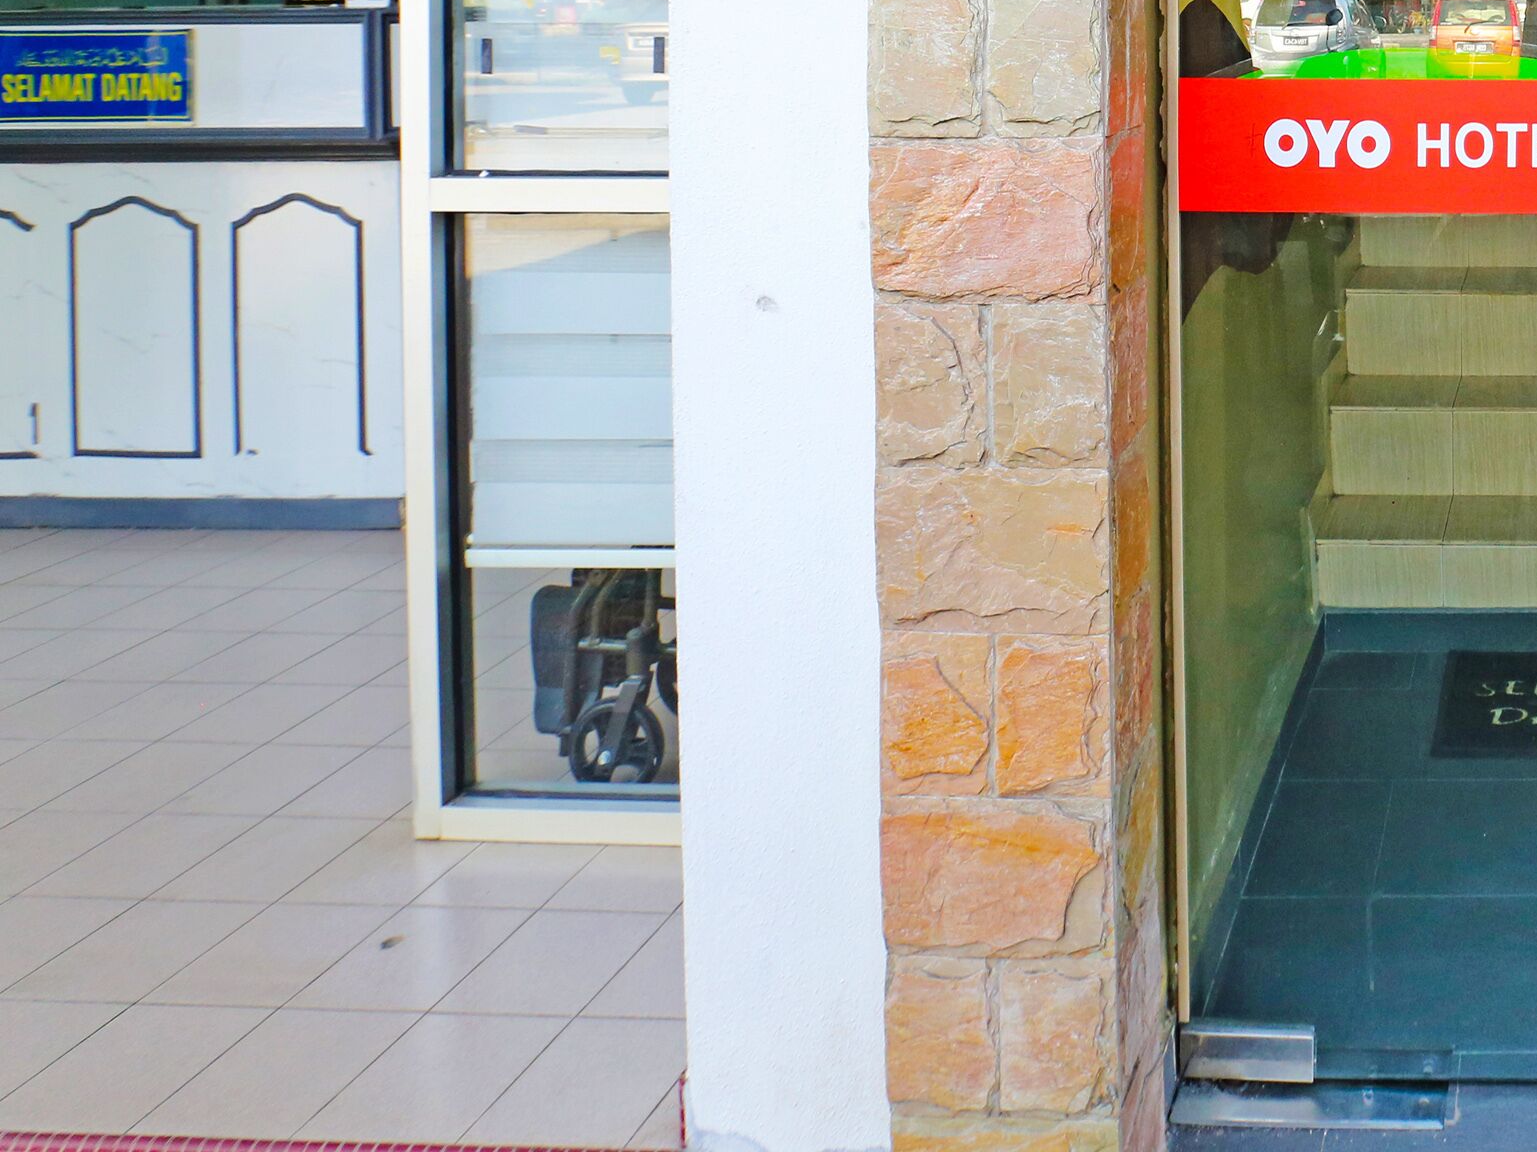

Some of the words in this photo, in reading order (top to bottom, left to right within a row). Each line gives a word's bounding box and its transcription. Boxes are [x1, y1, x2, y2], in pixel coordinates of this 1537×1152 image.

[1, 72, 96, 104] SELAMAT
[101, 71, 184, 103] DATANG
[1263, 116, 1392, 169] OYO
